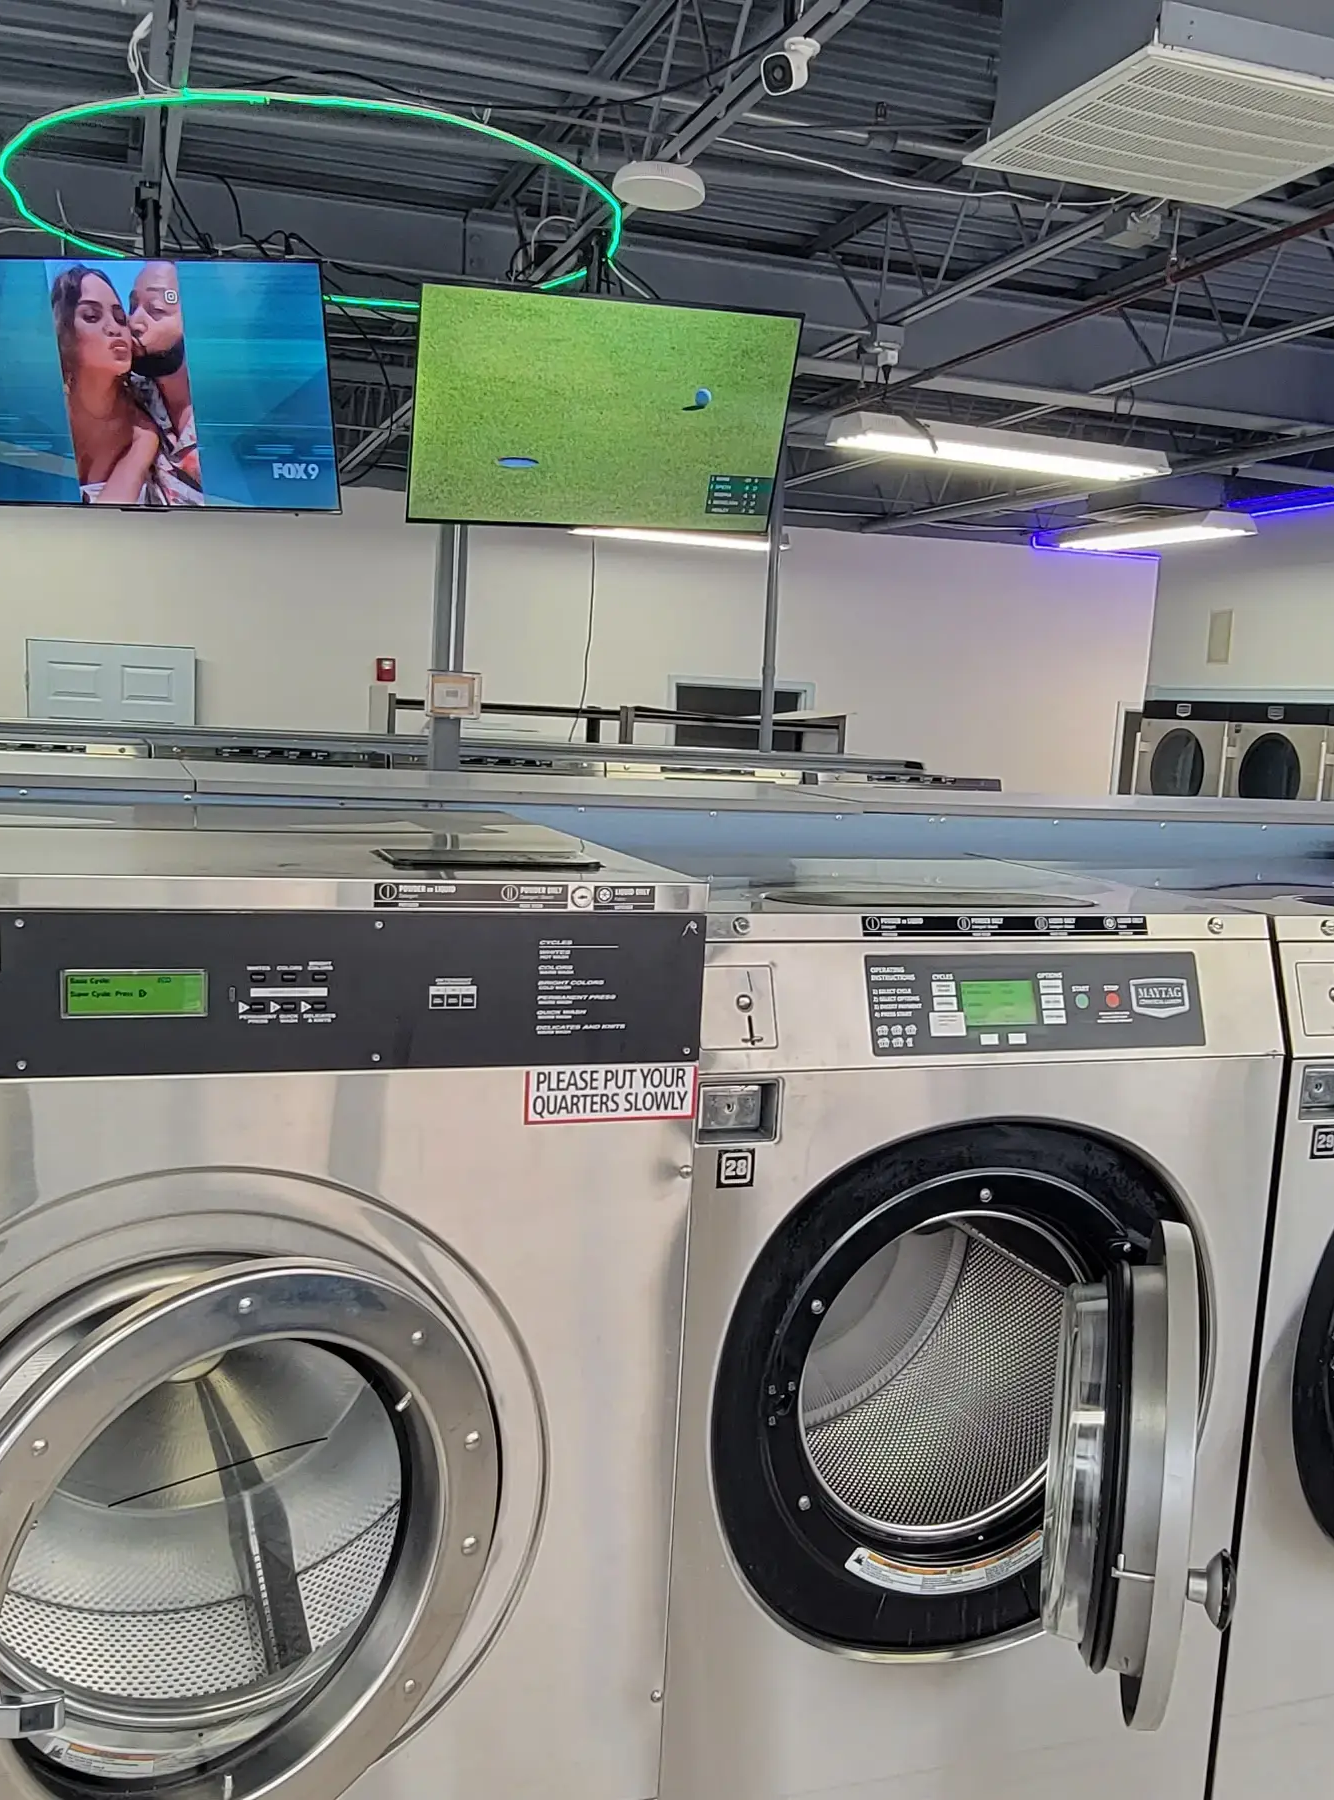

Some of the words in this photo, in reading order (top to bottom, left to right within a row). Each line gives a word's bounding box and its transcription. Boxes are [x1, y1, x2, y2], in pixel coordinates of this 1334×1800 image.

[272, 462, 307, 479] FOX
[308, 463, 319, 479] 9
[1138, 987, 1182, 999] MAYTAG
[536, 1070, 600, 1092] PLEASE
[603, 1068, 637, 1090] PUT
[640, 1067, 687, 1089] YOUR
[533, 1093, 620, 1118] QUARTERS
[623, 1090, 688, 1112] SLOWLY
[1317, 1134, 1334, 1149] 29
[724, 1159, 748, 1177] 28
